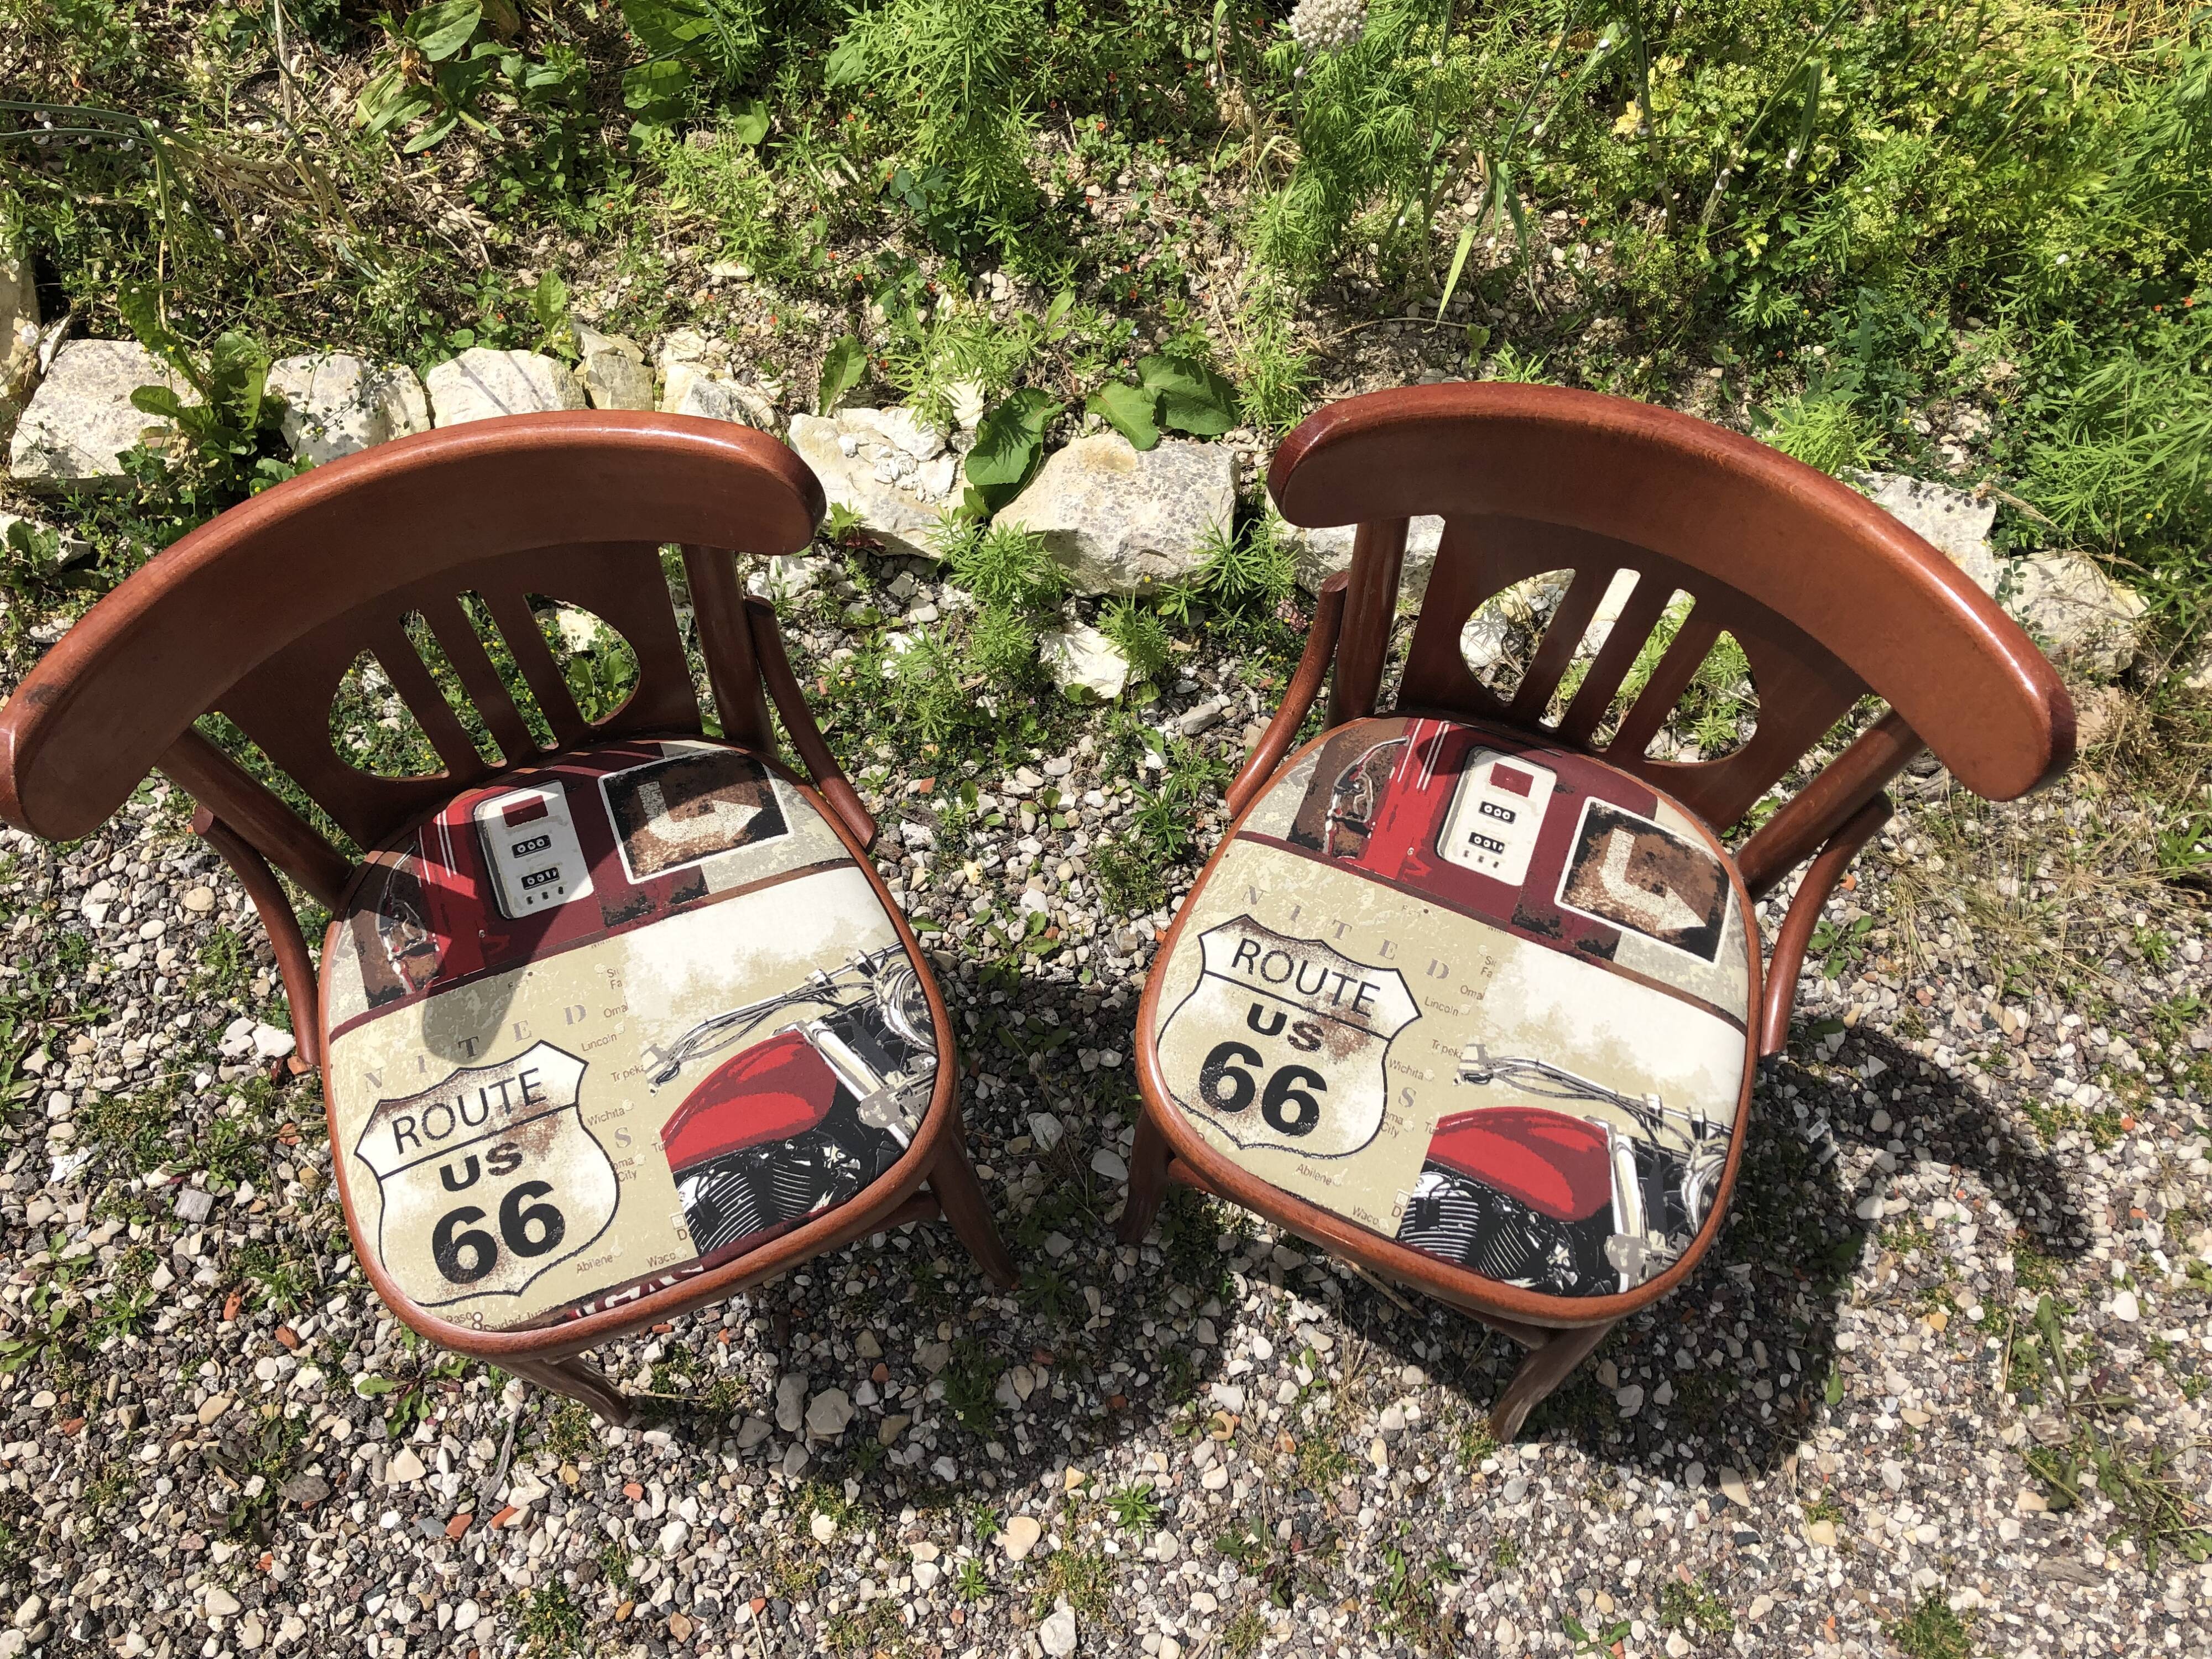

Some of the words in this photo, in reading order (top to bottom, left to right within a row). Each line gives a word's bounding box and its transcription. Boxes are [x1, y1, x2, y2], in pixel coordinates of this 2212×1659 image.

[1232, 937, 1381, 1018] ROUTE
[1424, 996, 1459, 1017] Lincoln
[1247, 1002, 1324, 1052] US
[581, 1032, 618, 1052] Lincoln
[1389, 1058, 1425, 1081] Wichita
[1198, 1041, 1328, 1137] 66
[392, 1067, 547, 1156] ROUTE
[587, 1107, 625, 1126] Wichita
[1380, 1121, 1400, 1139] City
[439, 1141, 523, 1192] US
[617, 1170, 638, 1182] City
[1296, 1163, 1332, 1186] Abilene
[1353, 1204, 1379, 1225] Waco
[432, 1180, 566, 1285] 66
[576, 1254, 613, 1274] Abilene
[646, 1251, 676, 1267] Waco
